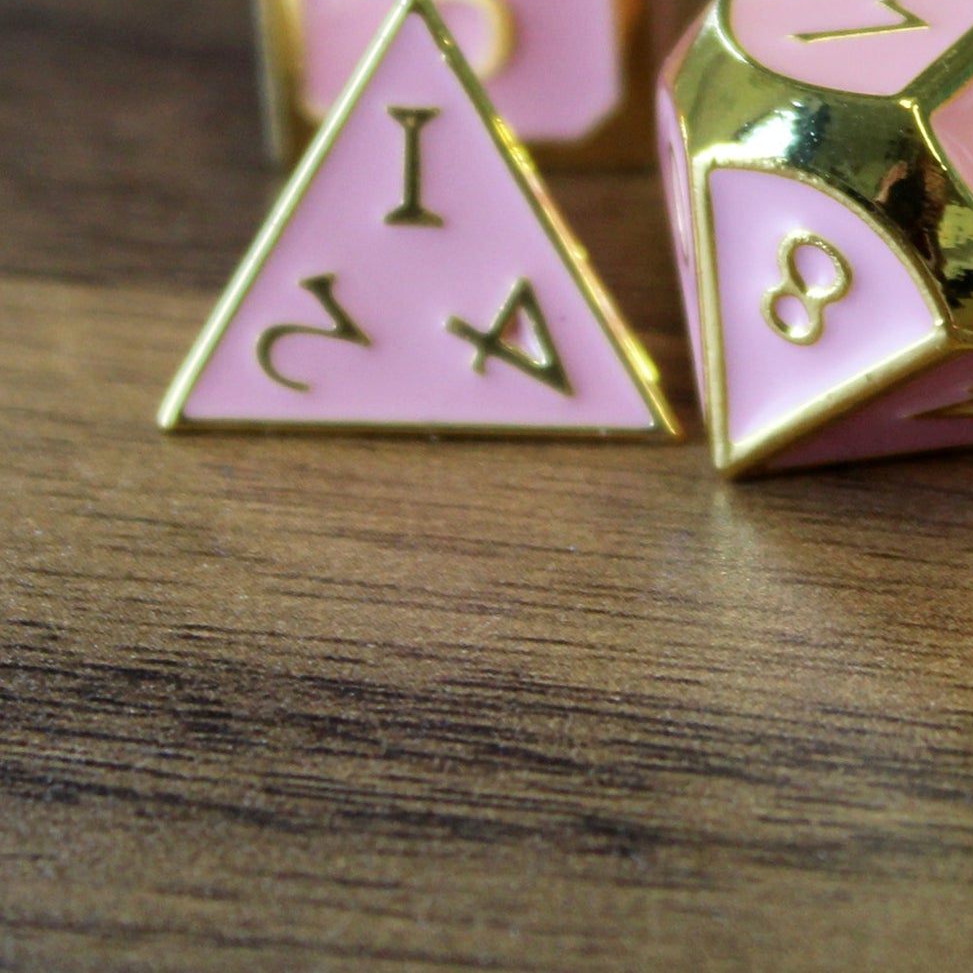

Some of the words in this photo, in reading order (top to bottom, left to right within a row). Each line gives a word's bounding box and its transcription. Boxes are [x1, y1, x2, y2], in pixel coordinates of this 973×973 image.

[383, 105, 447, 228] 1
[255, 271, 375, 394] 2
[443, 276, 577, 397] 4
[759, 228, 854, 346] 8
